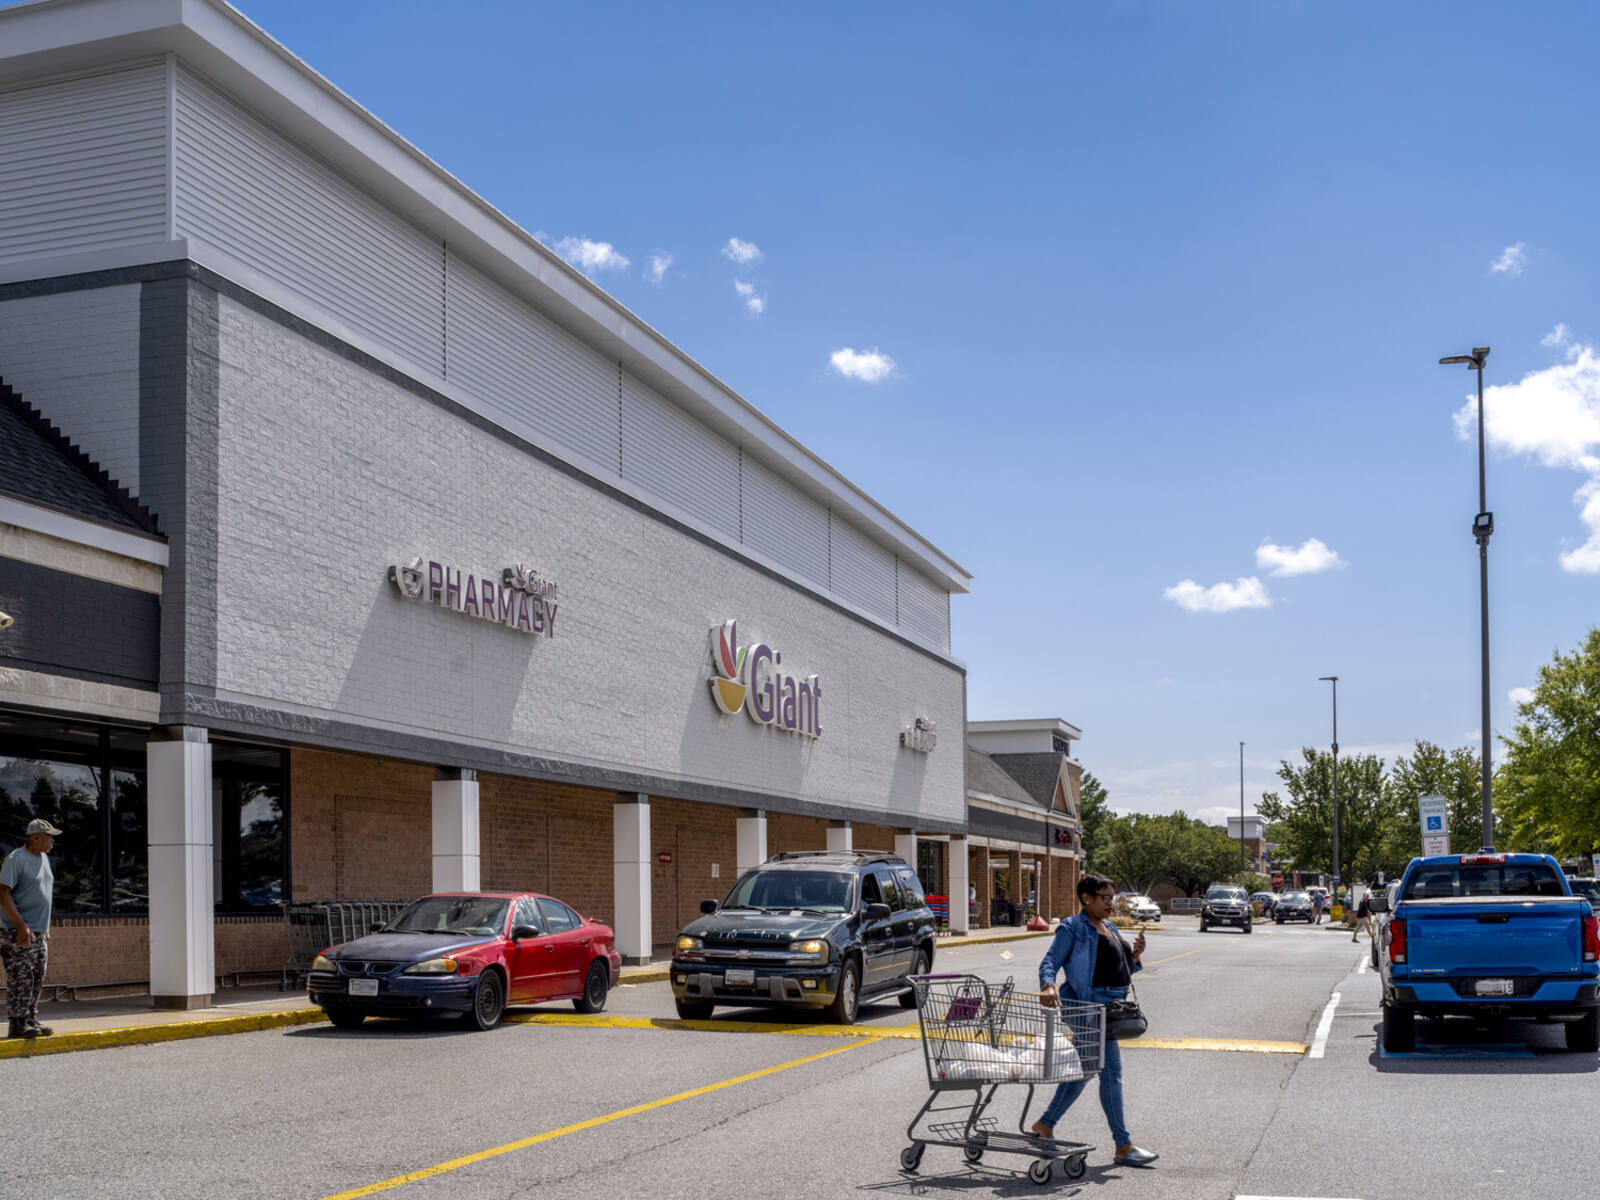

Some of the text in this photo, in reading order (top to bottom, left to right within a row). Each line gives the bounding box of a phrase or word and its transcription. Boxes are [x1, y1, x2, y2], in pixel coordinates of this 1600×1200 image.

[428, 560, 558, 639] PHARMACY
[528, 569, 559, 601] Giant
[749, 643, 822, 738] Giant
